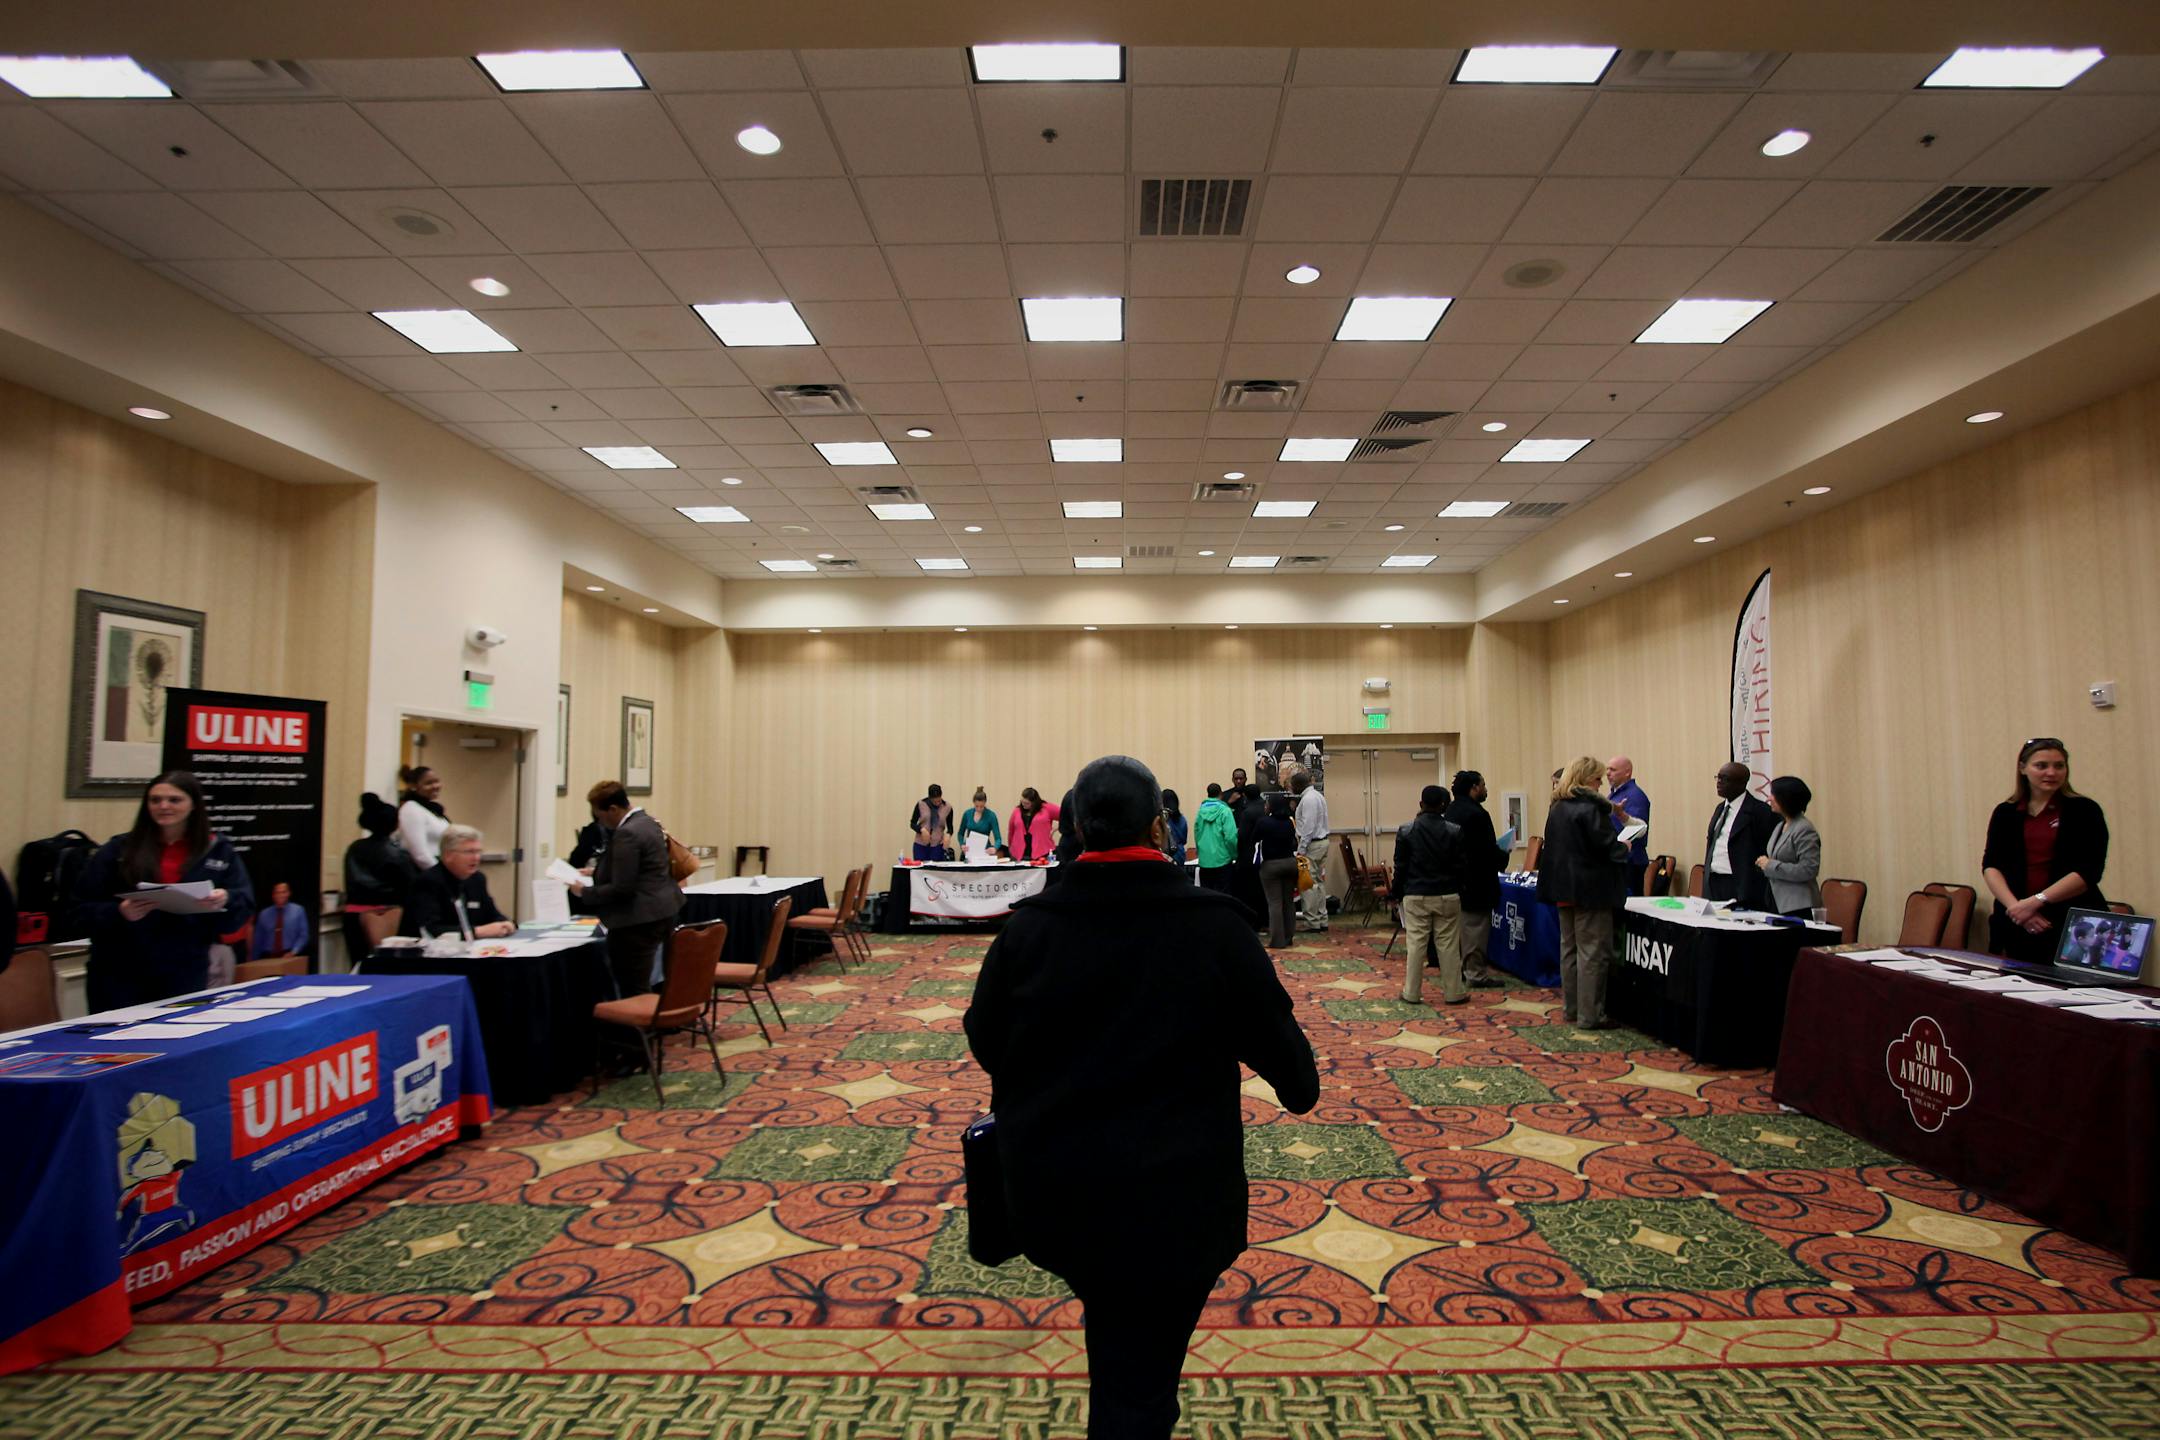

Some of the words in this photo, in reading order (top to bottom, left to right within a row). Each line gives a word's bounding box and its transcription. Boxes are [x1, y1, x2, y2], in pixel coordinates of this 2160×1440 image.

[195, 712, 304, 747] ULINE
[1625, 932, 1674, 976] INSAY
[1915, 1040, 1938, 1067] SAN
[241, 1044, 373, 1138] ULINE
[1900, 1058, 1953, 1096] ANTONIO
[179, 1219, 252, 1271] PASSION
[252, 1202, 289, 1233] AND
[291, 1156, 382, 1211] OPERATIONAL
[381, 1115, 455, 1164] EXCELLENCE
